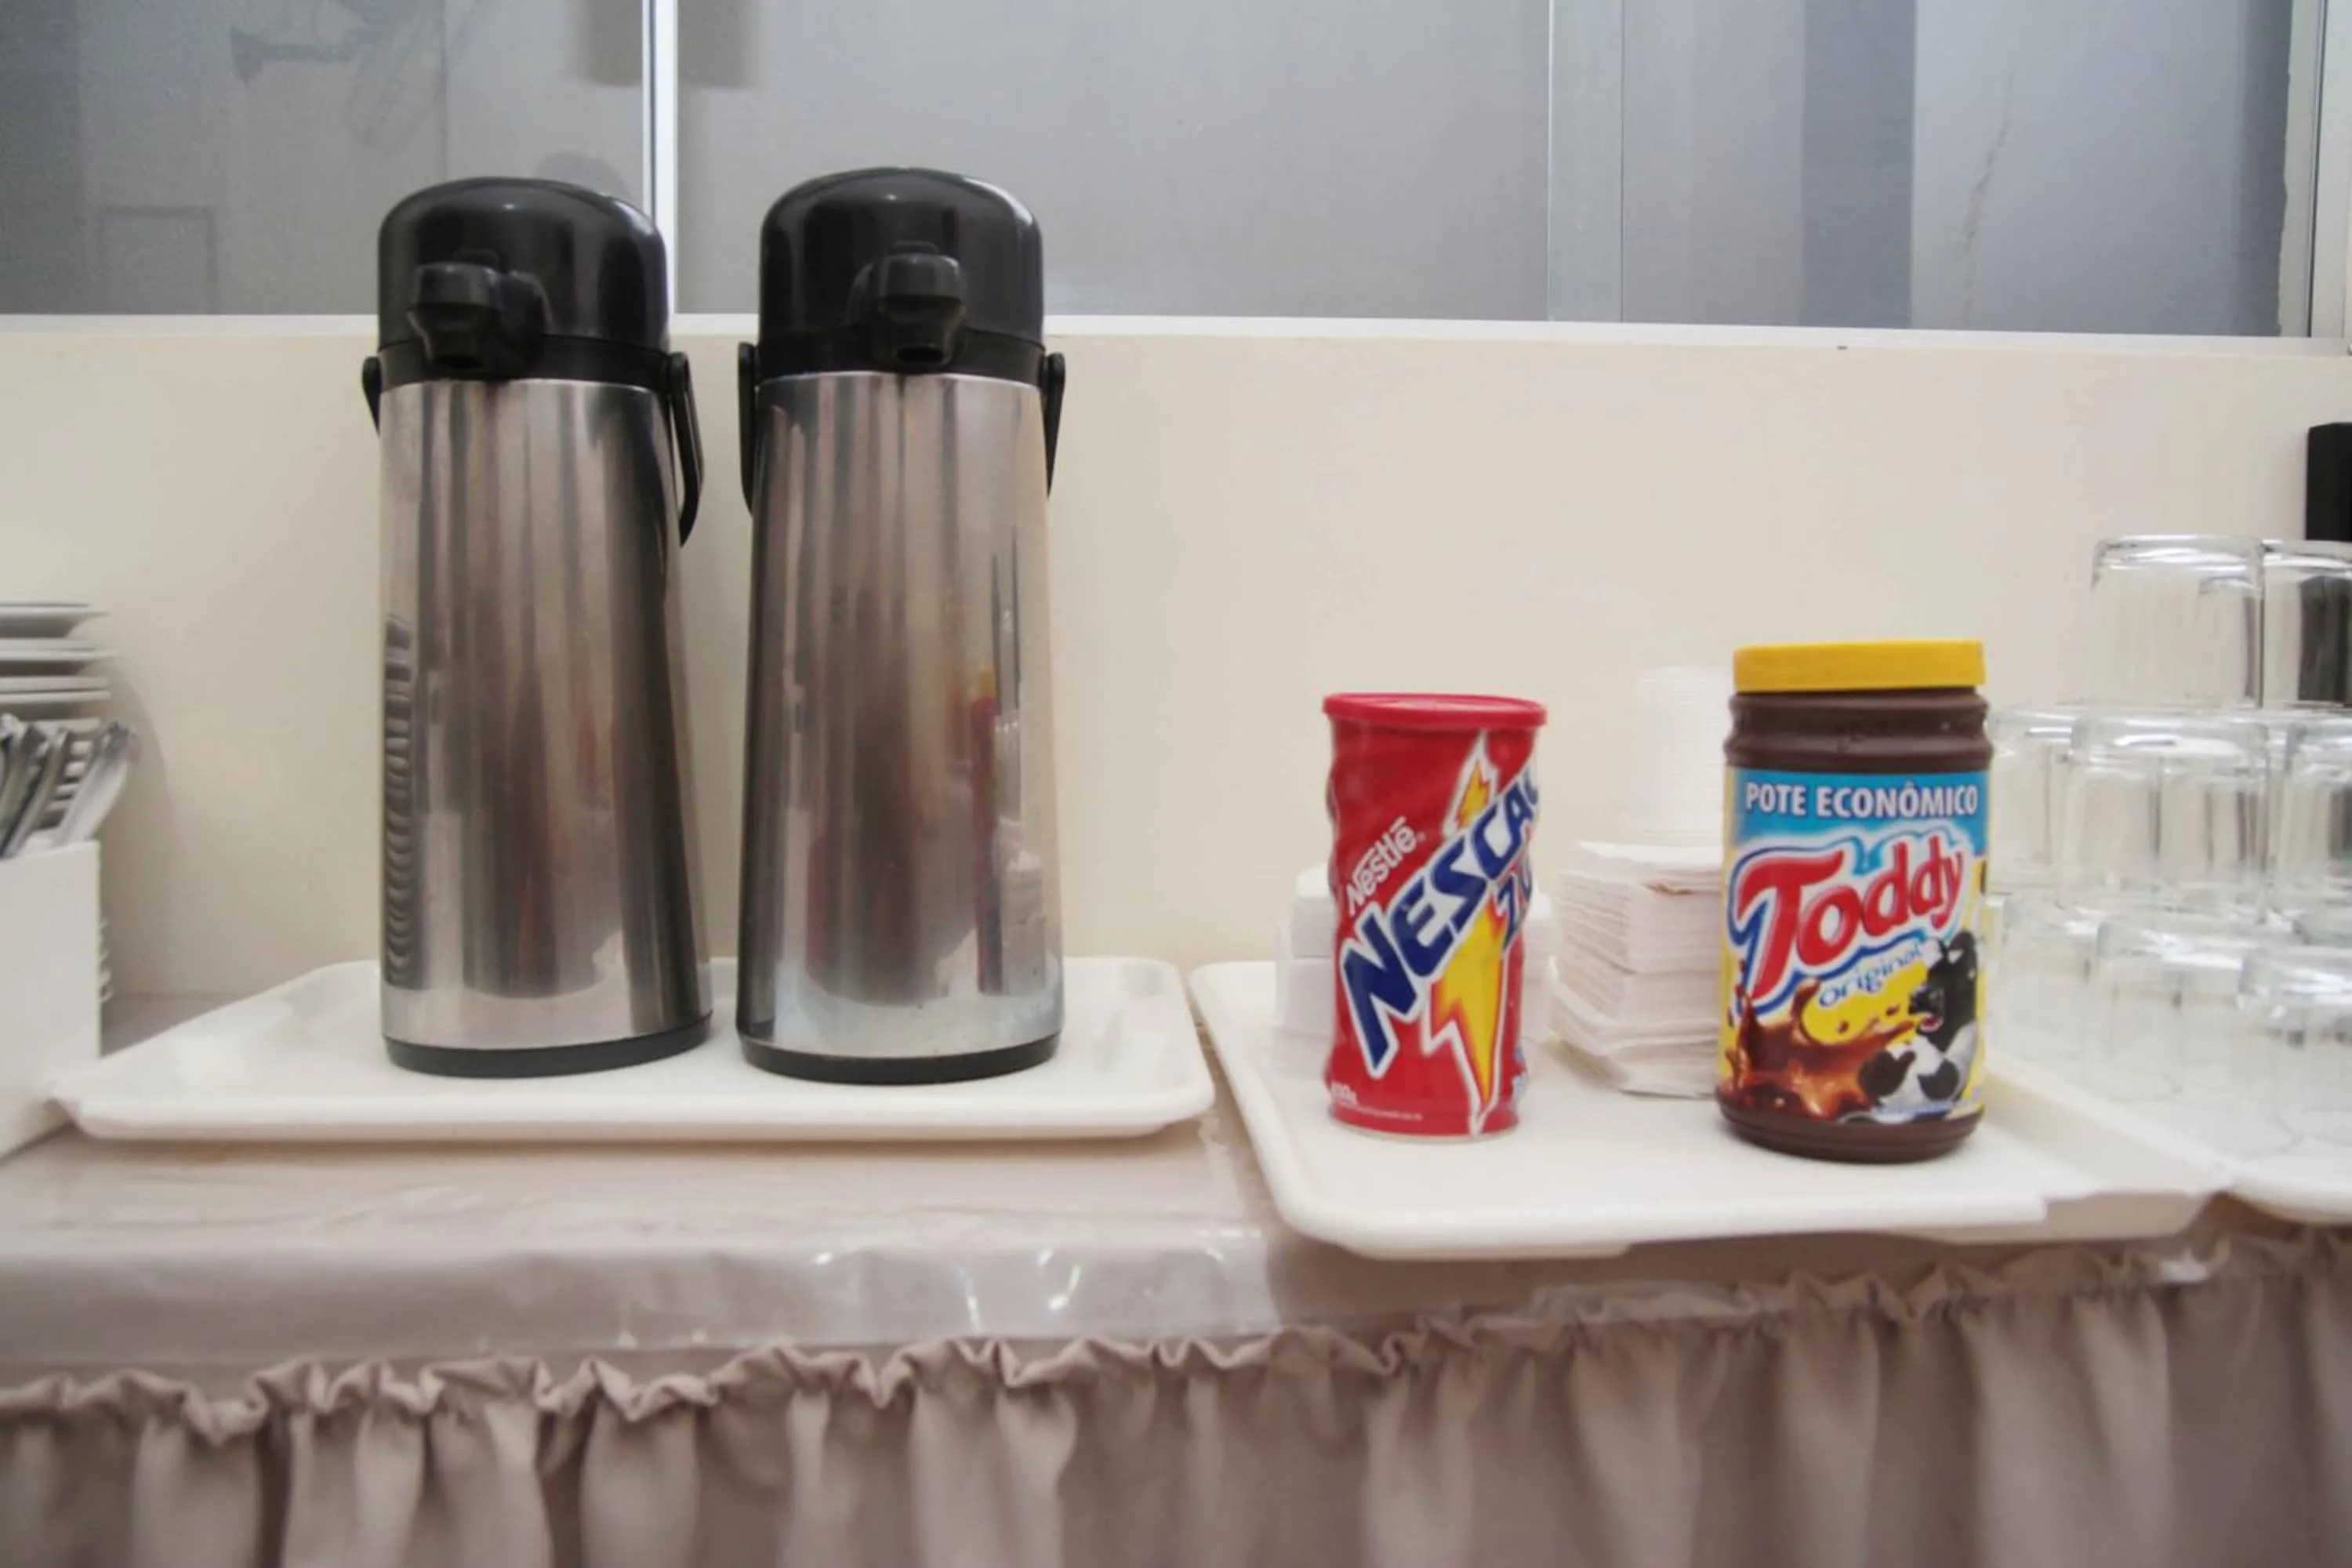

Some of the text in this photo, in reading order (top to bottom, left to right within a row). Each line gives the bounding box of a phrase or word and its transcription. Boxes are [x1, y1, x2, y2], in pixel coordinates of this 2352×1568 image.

[1746, 781, 1977, 818] POTE ECONÔMICO
[1737, 834, 1963, 1000] Toddy
